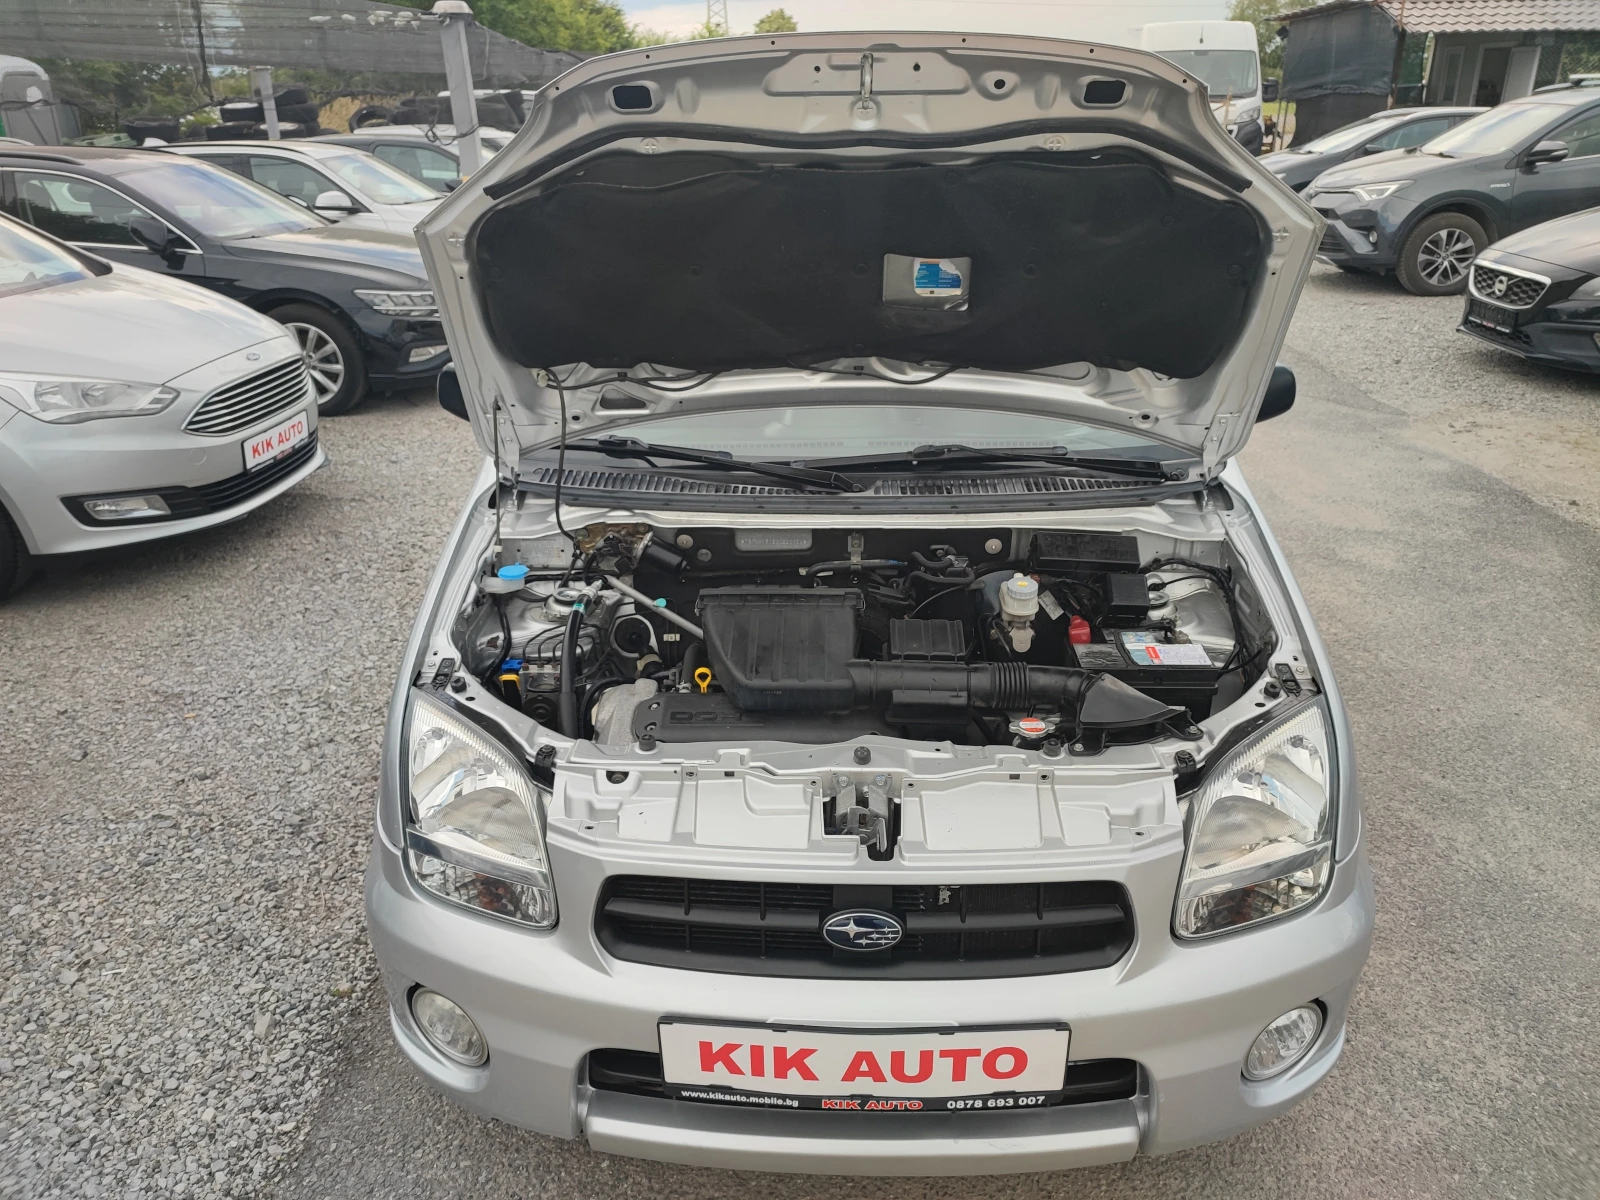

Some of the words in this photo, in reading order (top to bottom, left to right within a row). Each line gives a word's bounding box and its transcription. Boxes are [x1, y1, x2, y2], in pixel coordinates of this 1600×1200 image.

[251, 436, 274, 459] KIK
[277, 420, 304, 447] AUTO
[669, 711, 764, 722] DOH
[699, 1041, 820, 1081] KIK
[840, 1046, 1029, 1083] AUTO
[681, 1089, 799, 1107] www.kikauto.mobile.bg
[822, 1099, 861, 1110] KIK
[864, 1100, 923, 1111] AUTO
[947, 1100, 982, 1109] 0878
[987, 1098, 1014, 1108] 693
[1018, 1096, 1046, 1106] 007
